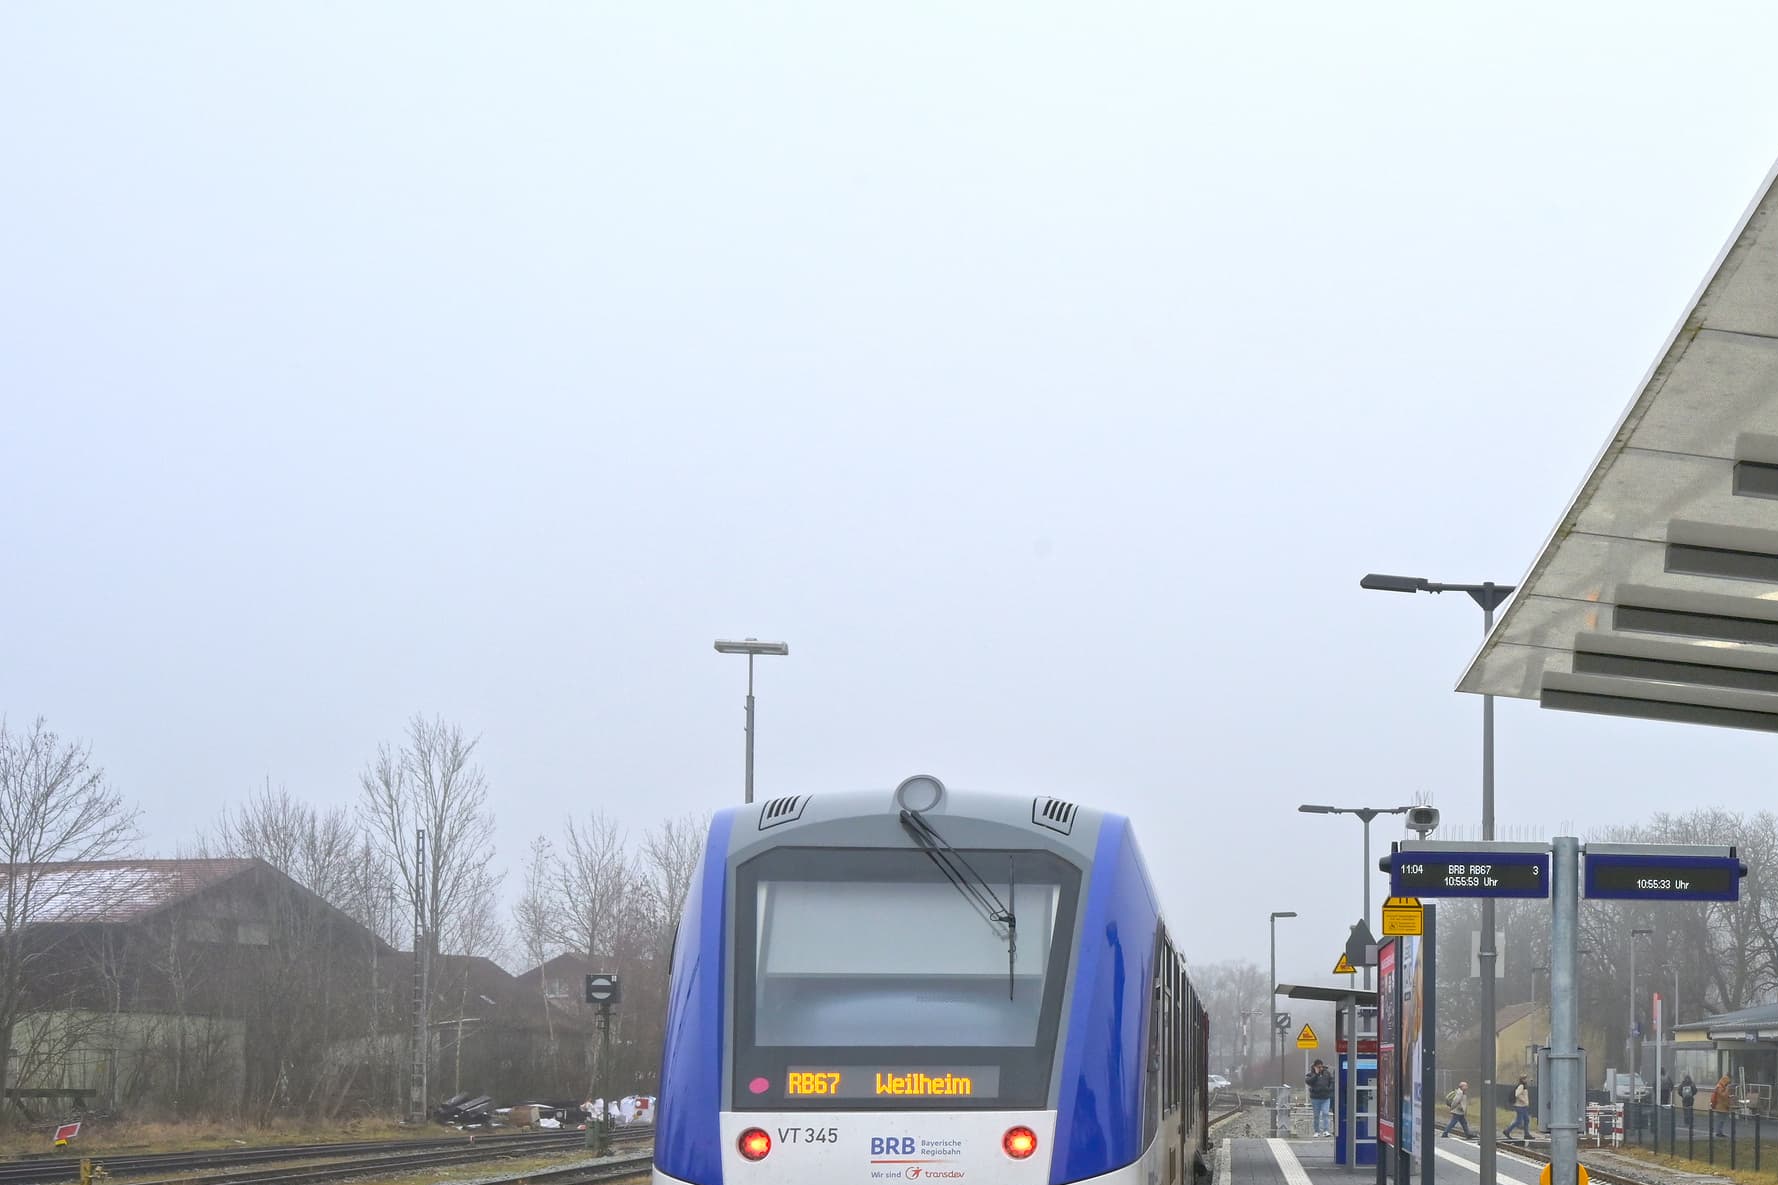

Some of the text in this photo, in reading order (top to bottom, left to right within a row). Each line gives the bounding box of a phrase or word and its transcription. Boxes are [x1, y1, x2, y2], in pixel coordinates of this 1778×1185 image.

[1400, 864, 1539, 876] 11:04 BRB RB67 3
[1483, 877, 1499, 887] Uhr
[1675, 879, 1690, 890] Uhr
[788, 1072, 972, 1095] RB67 Weilheim
[777, 1127, 839, 1144] VT 345
[870, 1136, 916, 1156] BRB
[920, 1139, 962, 1149] Bayerische
[920, 1148, 962, 1157] Regiobahn
[870, 1170, 966, 1179] Wir sind transdev
